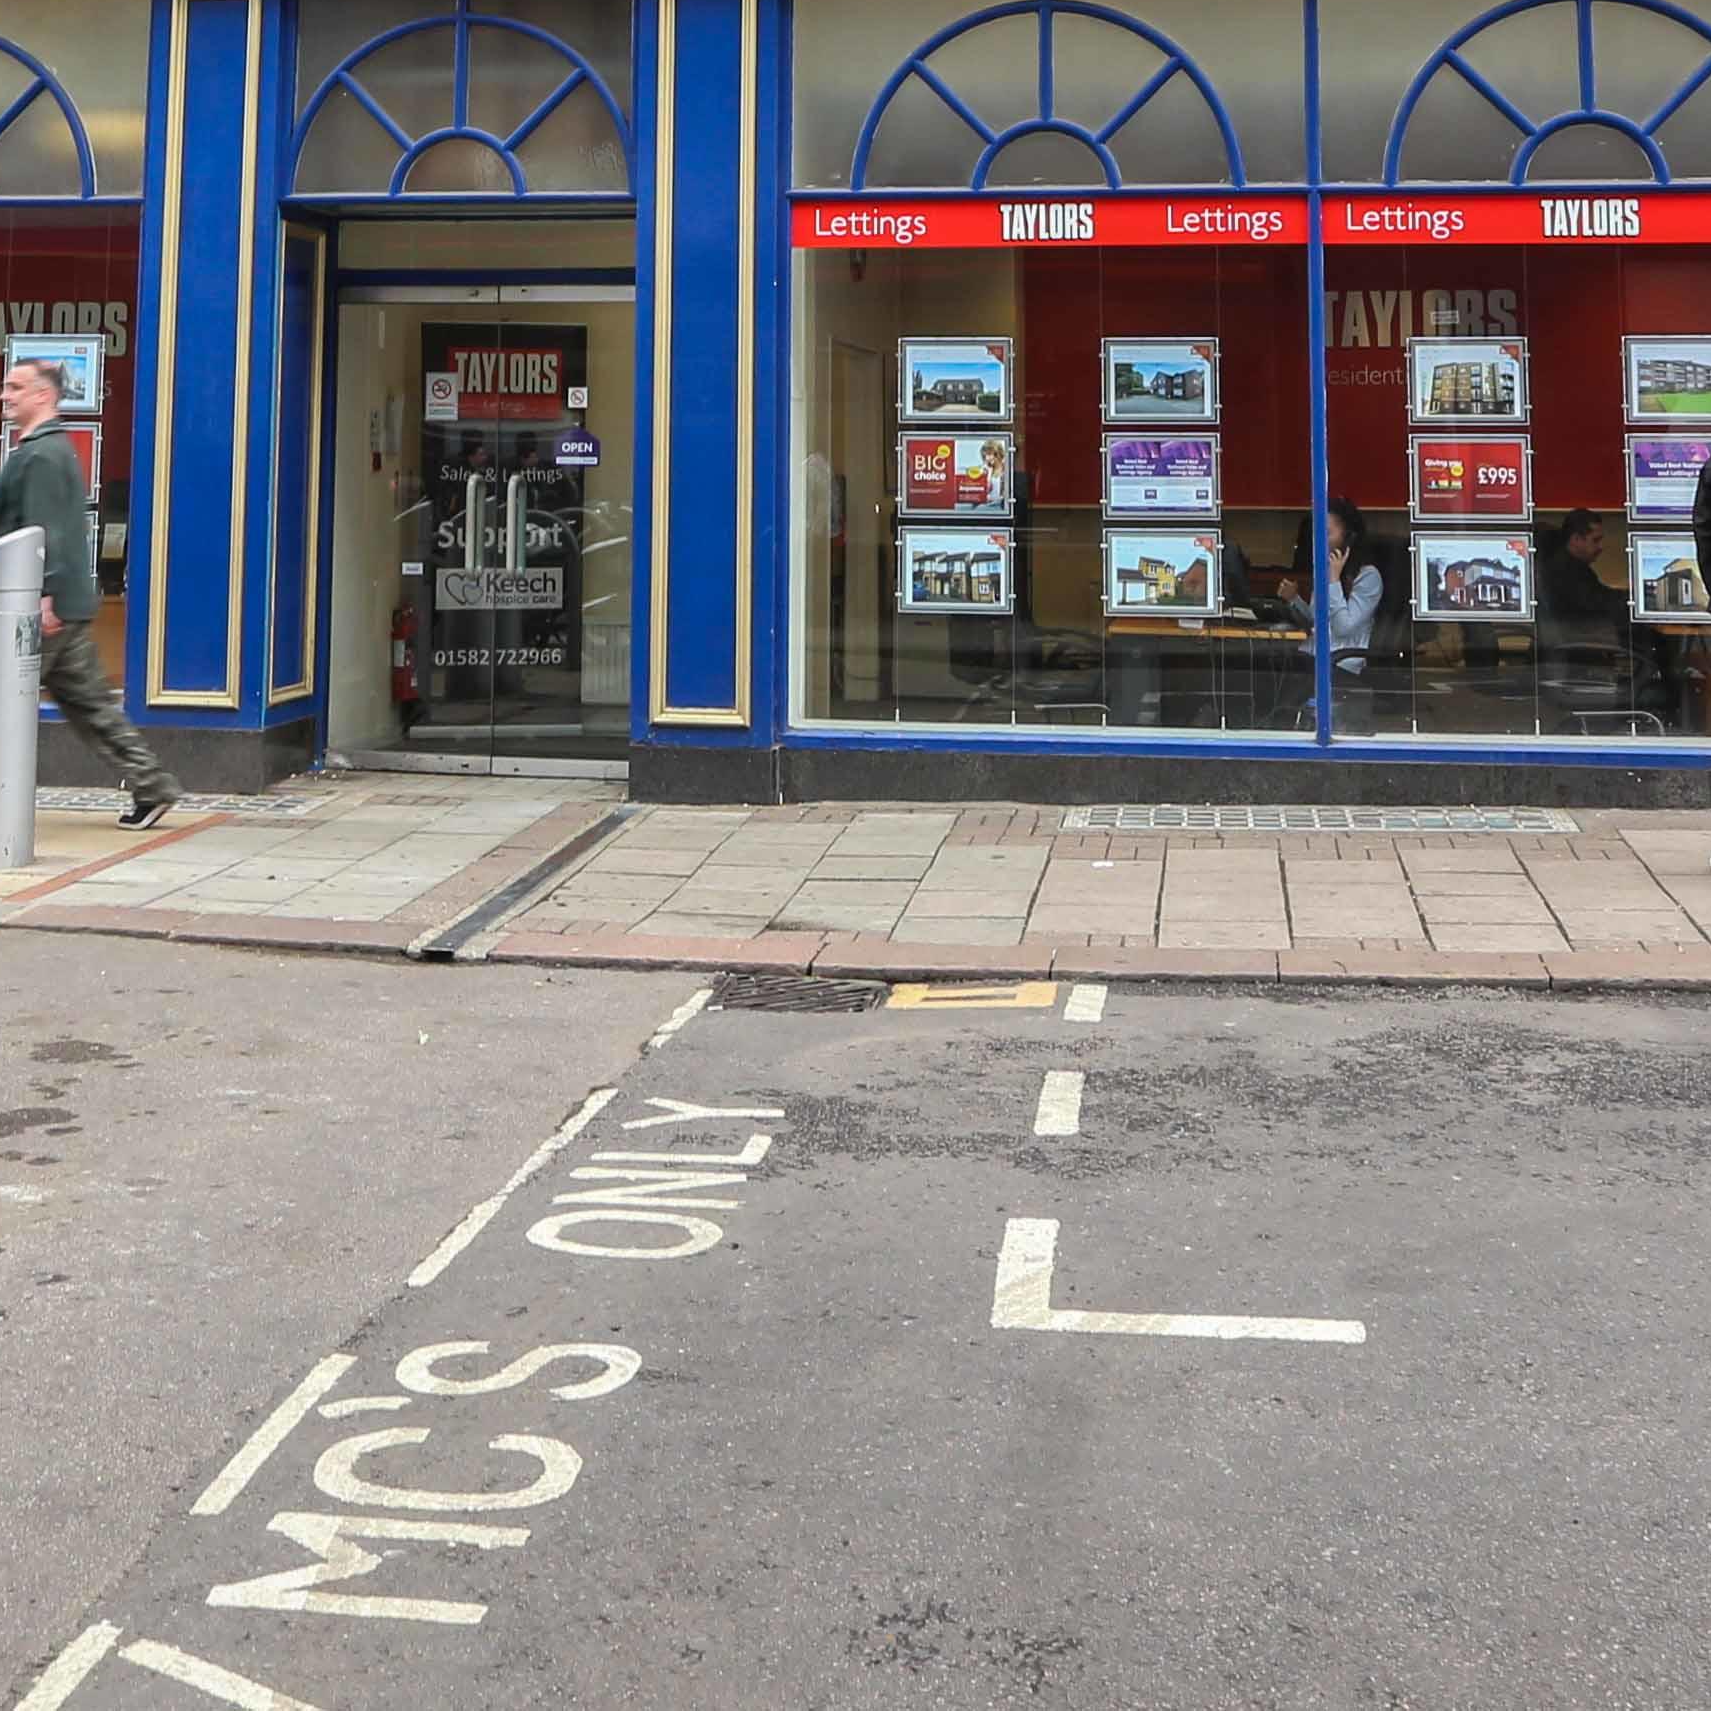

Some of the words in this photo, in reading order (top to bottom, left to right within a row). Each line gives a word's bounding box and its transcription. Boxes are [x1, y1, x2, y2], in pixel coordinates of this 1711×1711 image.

[814, 208, 927, 244] Lettings
[999, 202, 1095, 241] TAYLORS
[1166, 203, 1283, 240] Lettings
[1345, 202, 1466, 239] Lettings
[1540, 197, 1641, 237] TAYLORS
[454, 352, 559, 395] TAYLORS
[561, 442, 593, 453] OPEN
[914, 455, 947, 471] BIG
[440, 464, 472, 482] Sale
[484, 466, 498, 483] &
[503, 467, 563, 484] Lttings
[913, 471, 947, 481] choice
[1477, 466, 1518, 485] £995
[485, 572, 557, 595] Keech
[485, 593, 530, 606] hospice
[532, 594, 558, 604] care
[434, 649, 490, 667] 01582
[495, 647, 563, 666] 722966
[525, 1095, 787, 1260] ONLY
